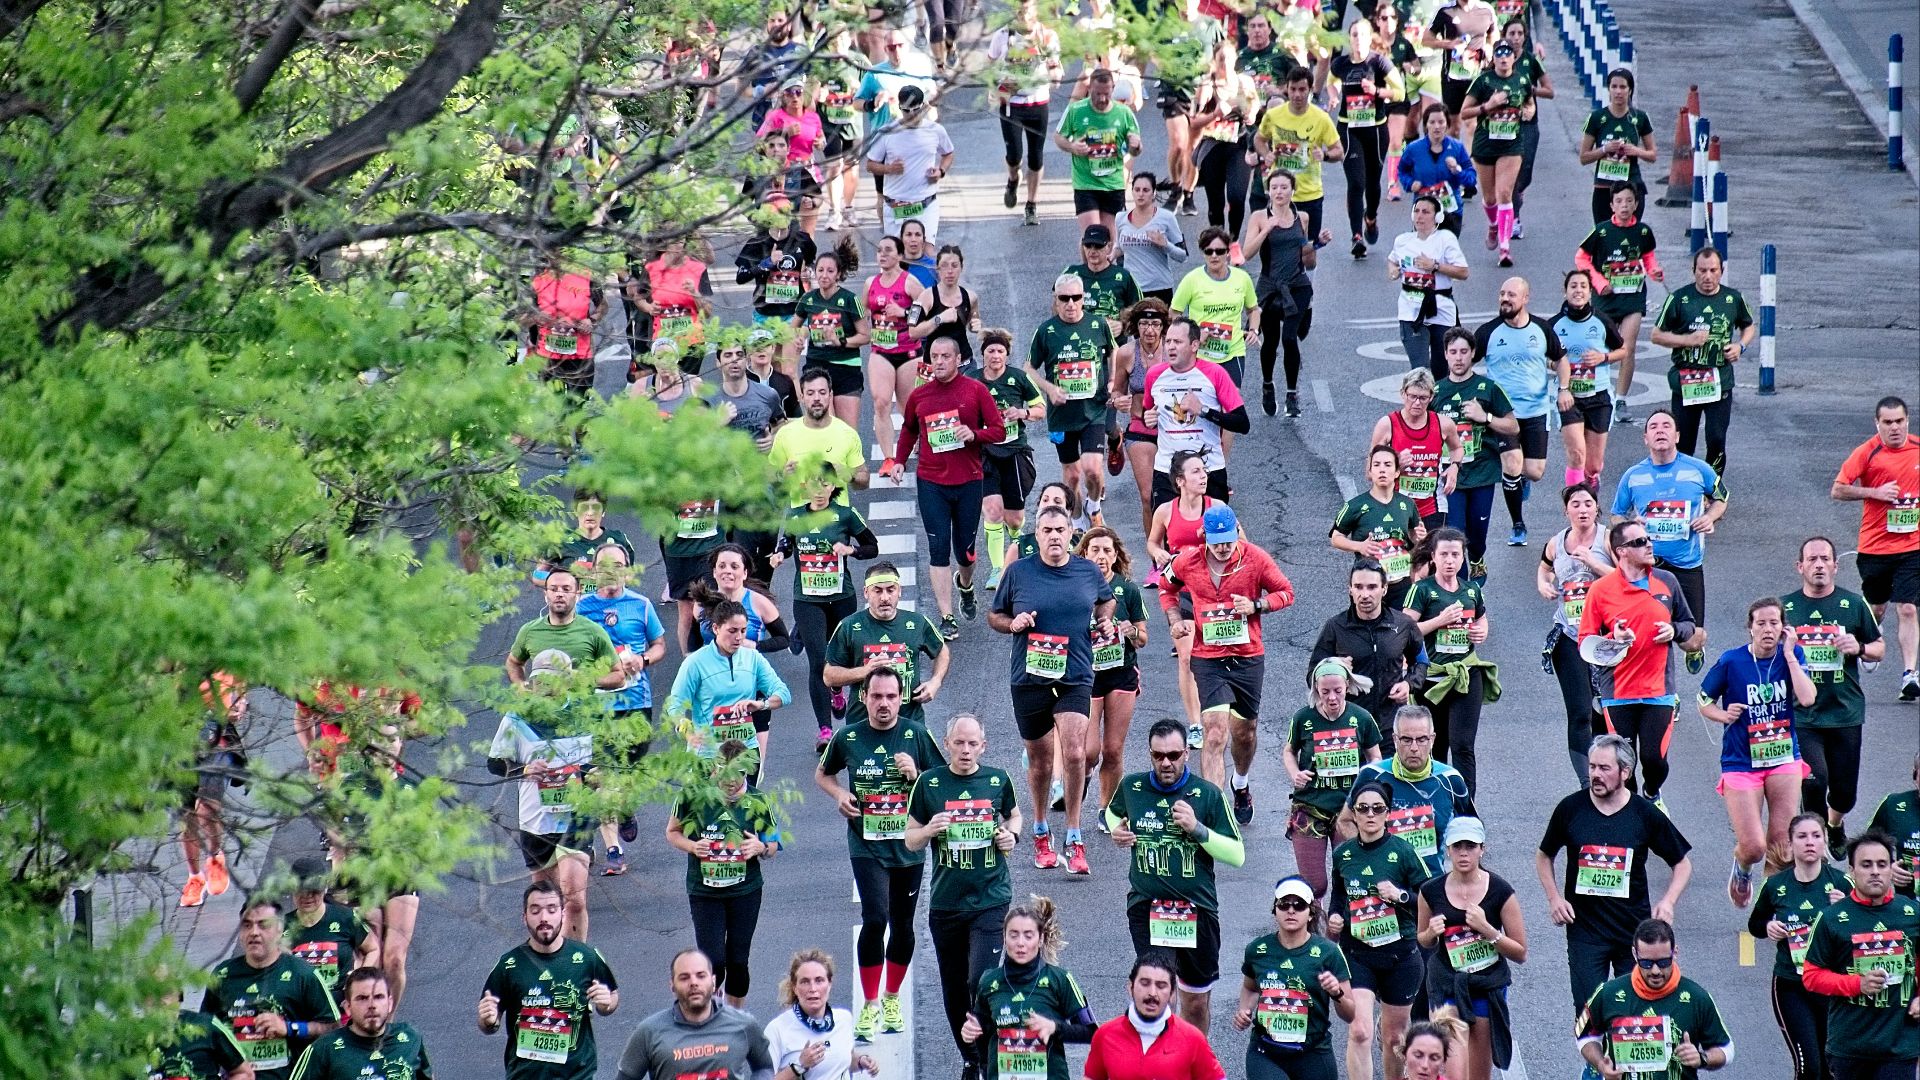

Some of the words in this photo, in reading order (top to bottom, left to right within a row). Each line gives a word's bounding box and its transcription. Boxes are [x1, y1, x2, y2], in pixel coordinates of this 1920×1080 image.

[1411, 453, 1438, 461] NMARK
[1658, 522, 1677, 532] 26301
[1216, 625, 1236, 637] 43163
[1096, 649, 1115, 662] 40901
[1810, 650, 1832, 661] 42954
[1038, 657, 1058, 670] 42936
[1747, 680, 1787, 705] RN
[1749, 705, 1768, 718] FOR
[1771, 702, 1787, 713] THE
[856, 768, 883, 776] MADRID
[877, 820, 900, 832] 42804
[1136, 821, 1163, 830] MADRID
[961, 827, 985, 839] 41756
[1591, 874, 1616, 887] 42572
[1165, 926, 1187, 937] 41644
[1260, 982, 1286, 990] MADRID
[521, 998, 551, 1007] MADRID
[533, 1037, 559, 1051] 42859
[252, 1045, 277, 1059] 42384
[1630, 1047, 1656, 1061] 42659
